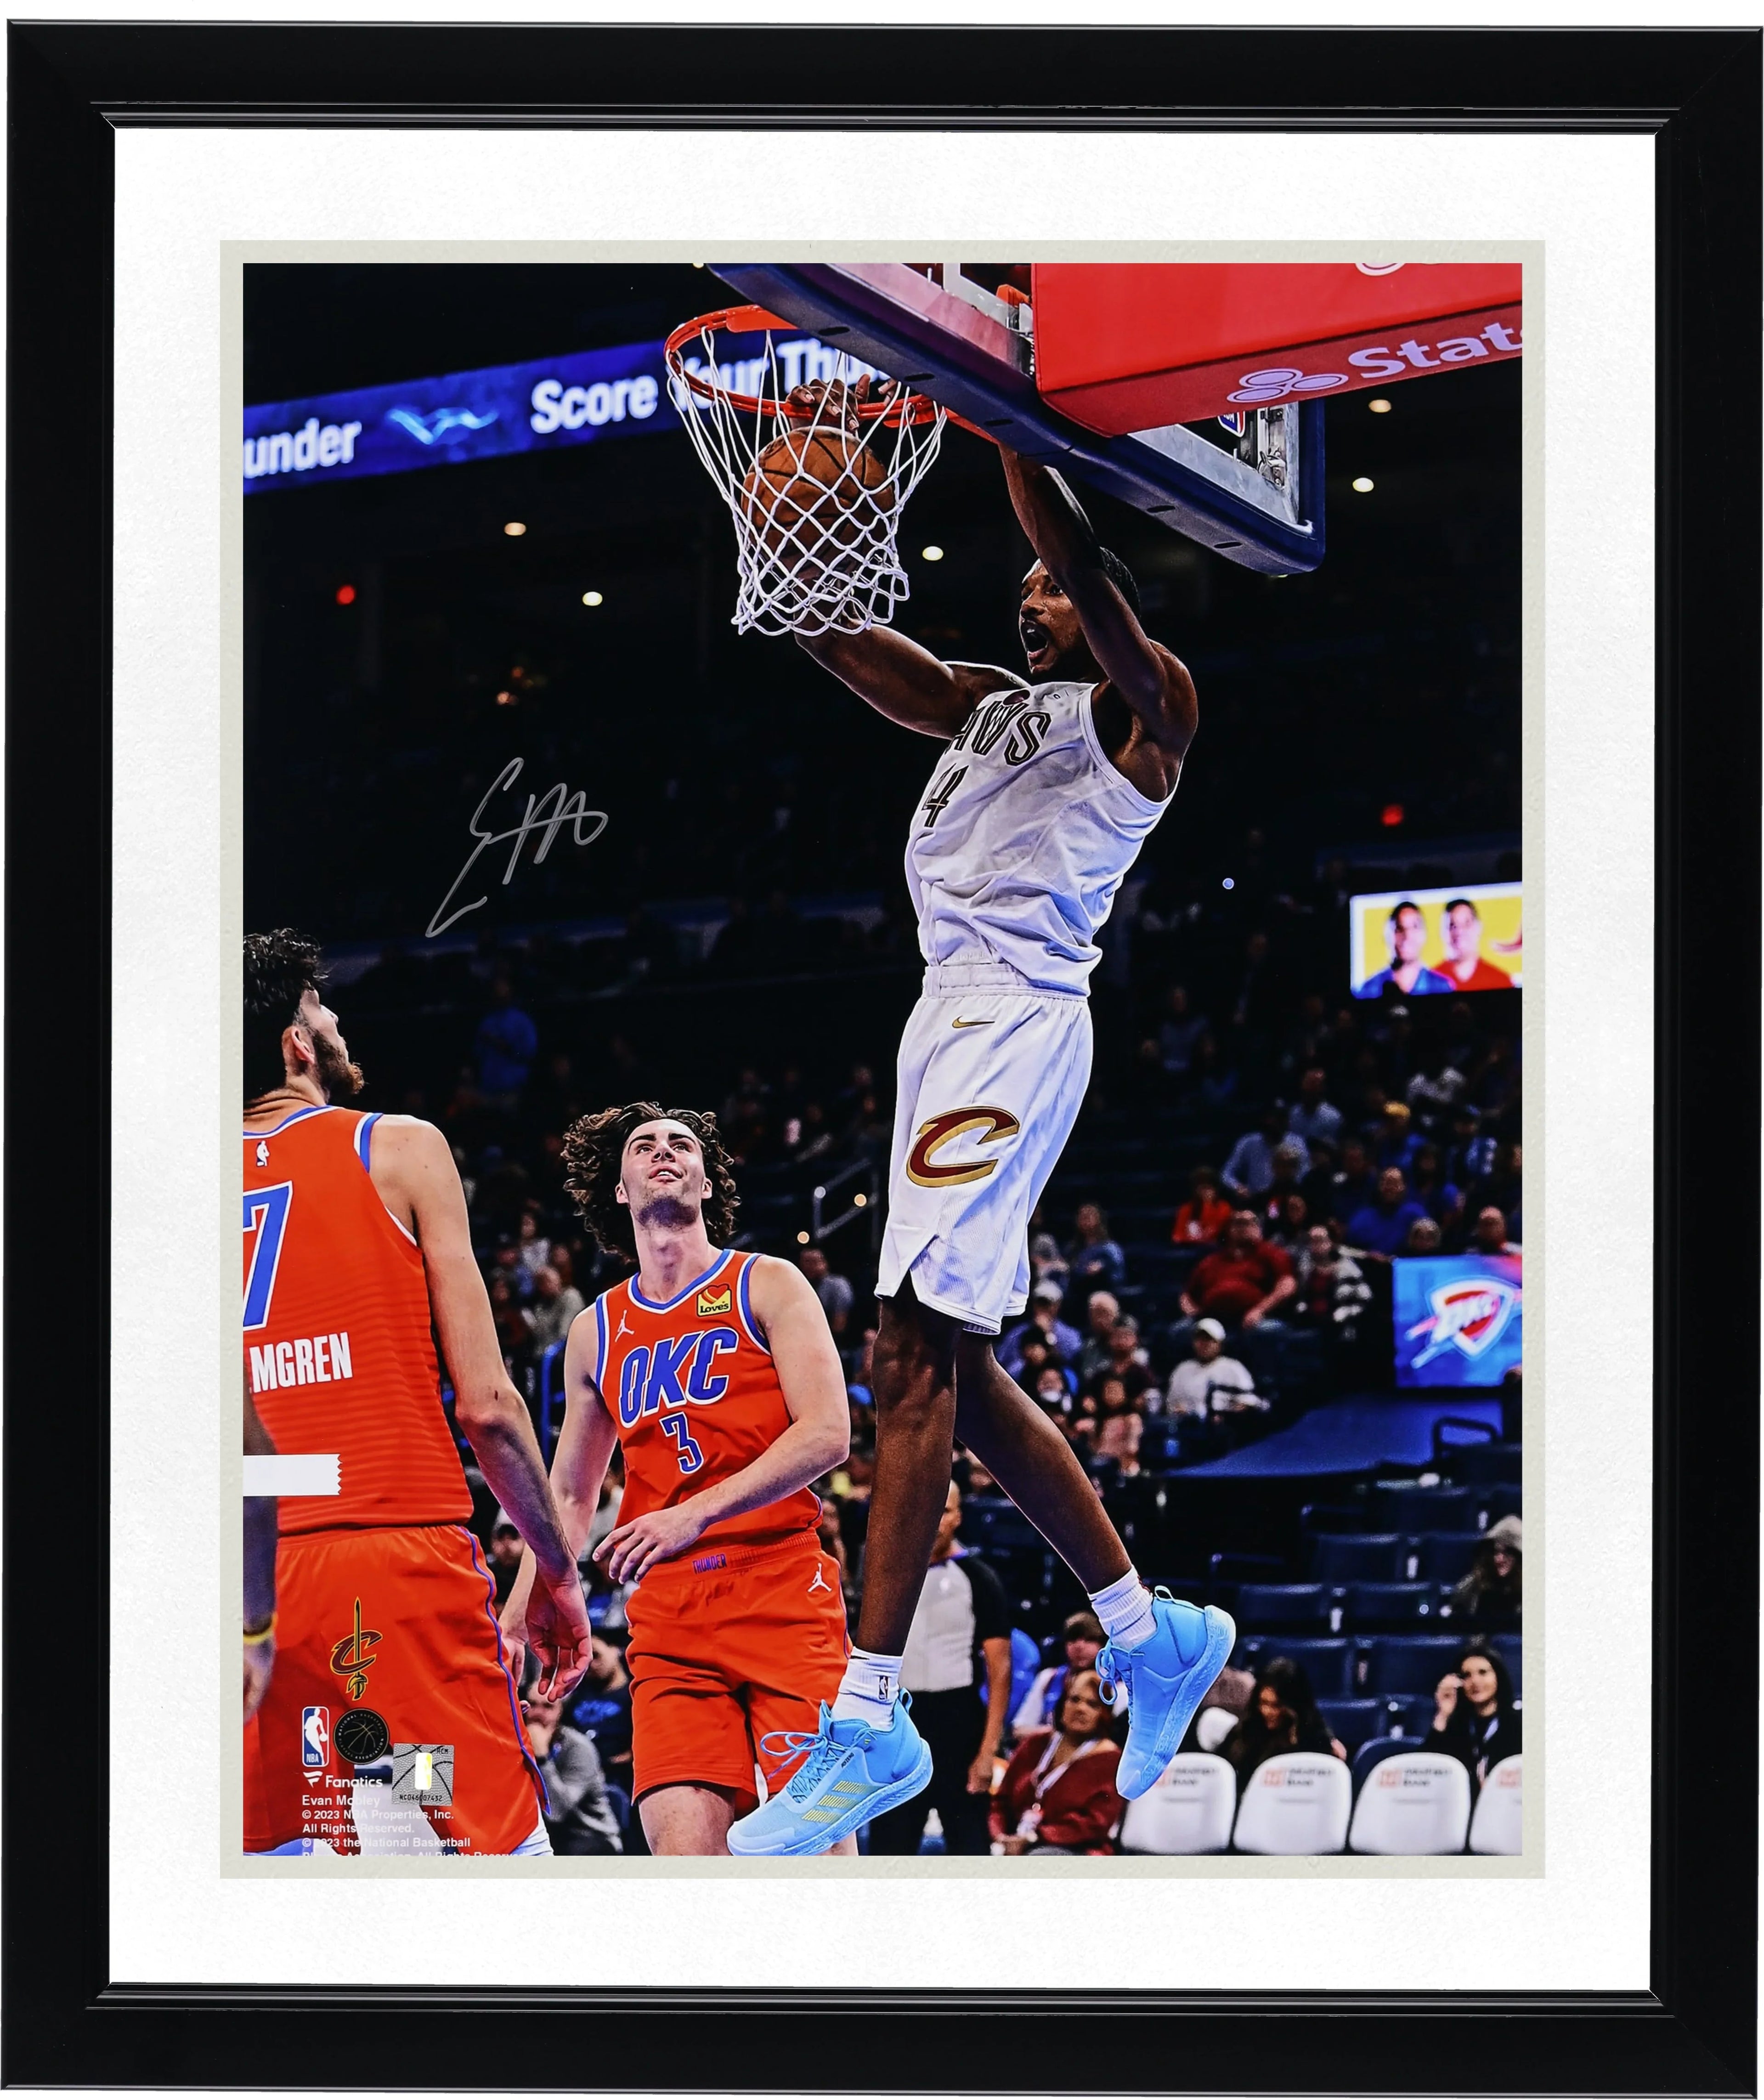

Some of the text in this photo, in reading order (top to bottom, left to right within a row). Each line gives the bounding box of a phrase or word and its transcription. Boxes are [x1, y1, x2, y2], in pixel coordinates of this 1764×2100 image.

[1348, 323, 1522, 378] Stat
[243, 419, 362, 478] under
[531, 375, 658, 434] Score
[922, 763, 969, 827] 4
[243, 1180, 293, 1331] 7
[249, 1332, 353, 1393] MGREN
[618, 1327, 738, 1429] OKC
[660, 1411, 704, 1473] 3
[693, 1553, 727, 1574] THUNDER
